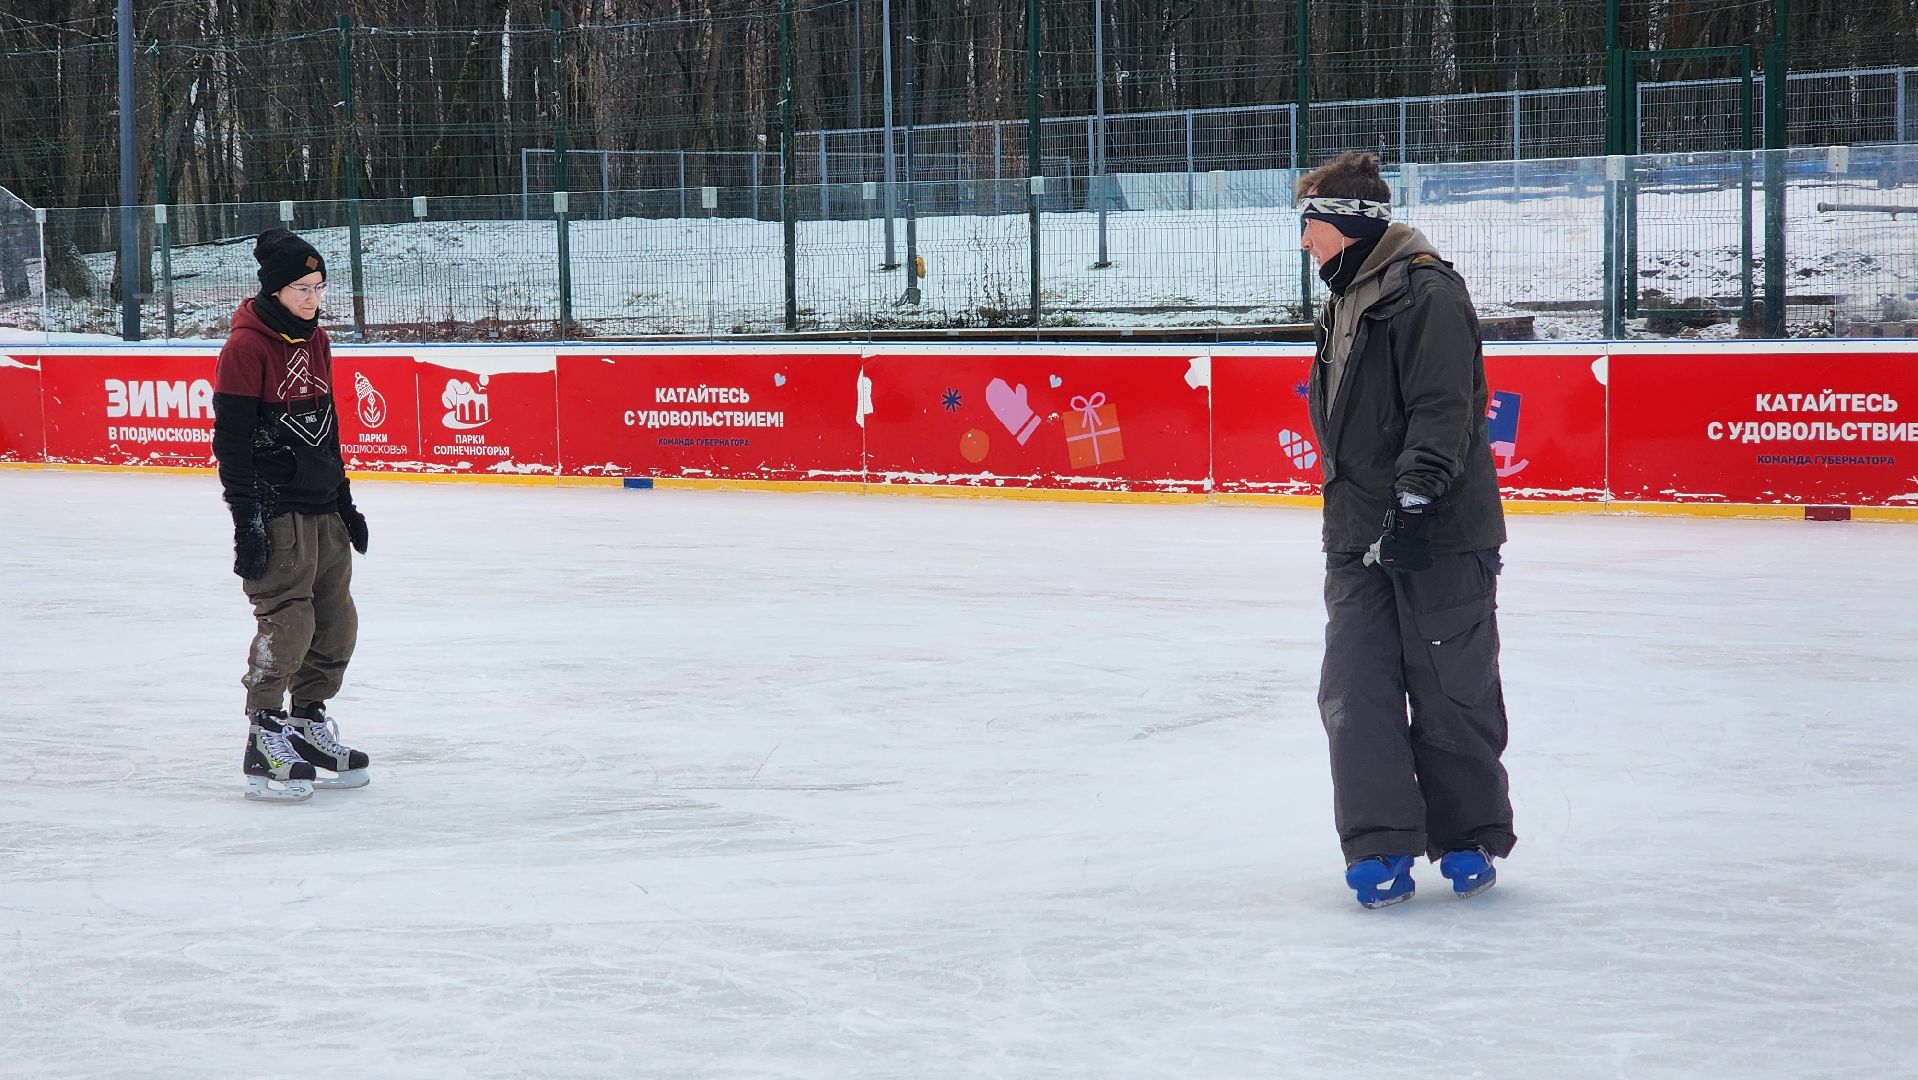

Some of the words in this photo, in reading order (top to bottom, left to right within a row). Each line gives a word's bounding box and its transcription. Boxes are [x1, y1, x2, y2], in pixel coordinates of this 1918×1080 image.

[105, 379, 216, 418] ЗИМА
[655, 384, 750, 404] КАТАЙТЕСЬ
[1756, 388, 1899, 413] КАТАЙТЕСЬ
[624, 410, 635, 426] С
[637, 410, 784, 428] УДОВОЛЬСТВИЕМ!
[108, 426, 117, 440] В
[1707, 421, 1723, 441] С
[359, 433, 388, 443] ПАРКИ
[455, 434, 485, 445] ПАРКИ
[658, 437, 695, 447] КОМАНДА
[696, 438, 750, 447] ГУБЕРНАТОРА
[341, 444, 407, 455] ПОДМОСКОВЬЯ
[433, 445, 510, 456] СОЛНЕЧНОГОРЬЯ
[1757, 455, 1812, 466] КОМАНДА
[1814, 455, 1895, 465] ГУБЕРНАТОРА
